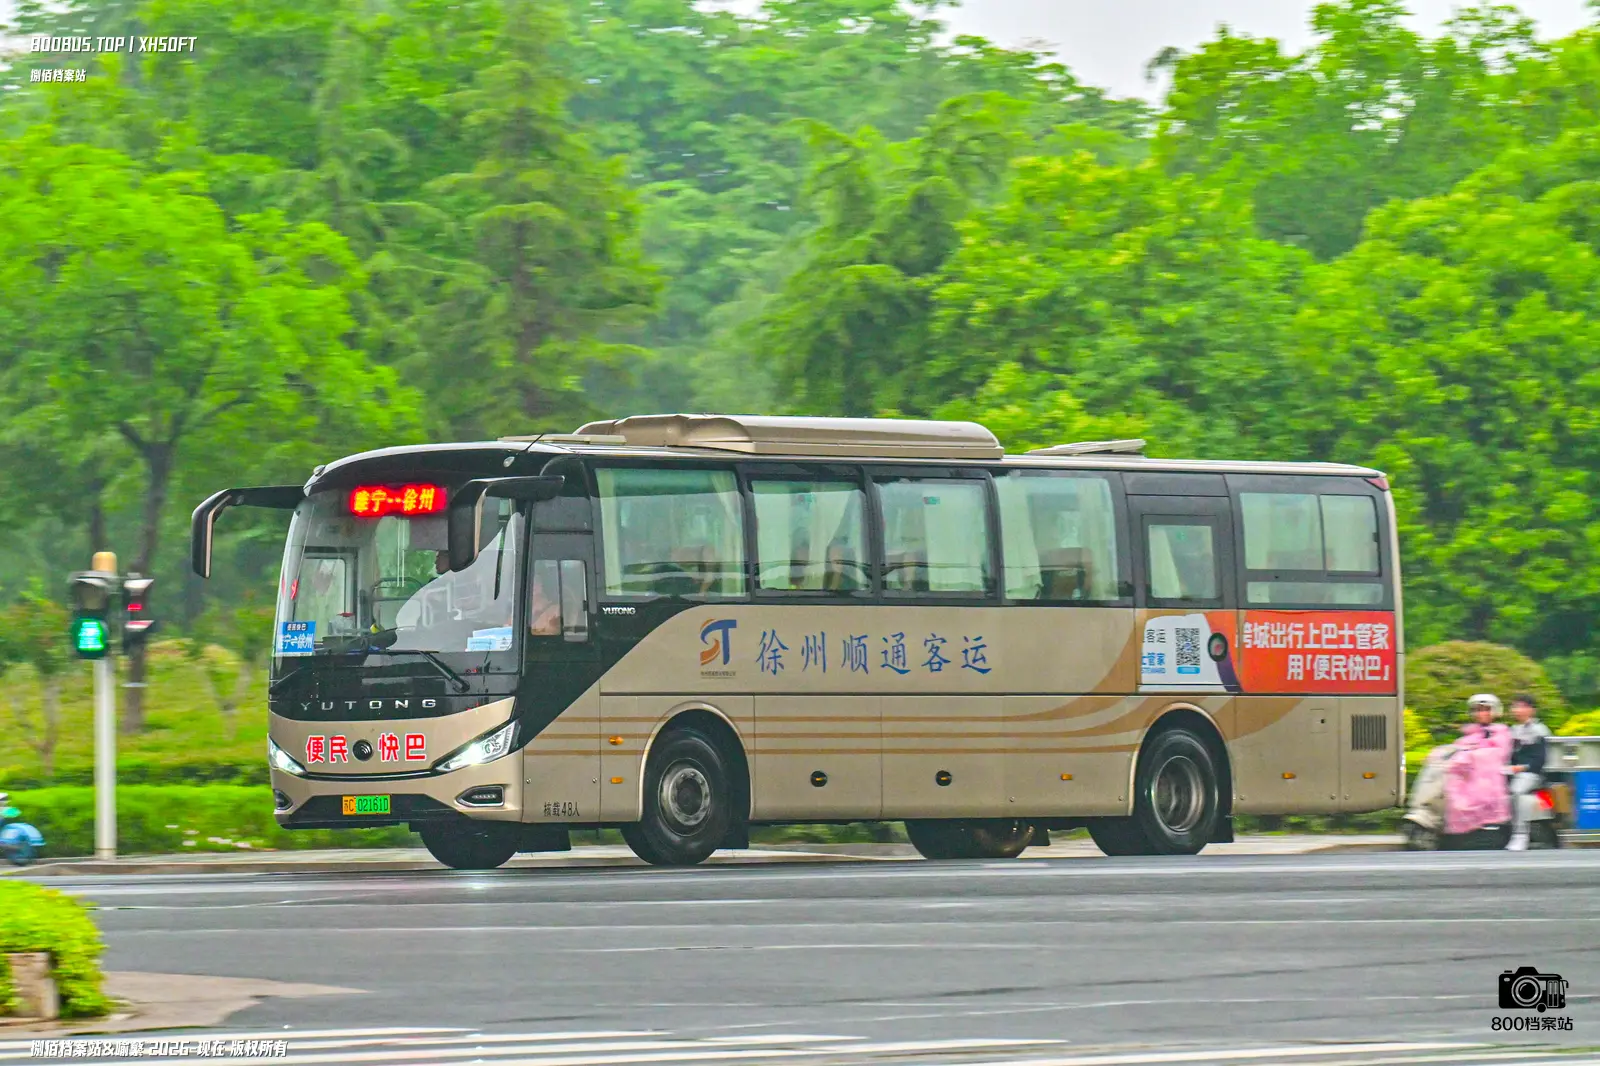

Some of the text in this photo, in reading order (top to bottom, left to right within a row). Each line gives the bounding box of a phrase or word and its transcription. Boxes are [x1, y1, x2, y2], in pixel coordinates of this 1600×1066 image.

[602, 606, 637, 615] YUTONG
[755, 629, 993, 675] 徐州顺通客运
[300, 698, 437, 711] YUTONG
[305, 732, 426, 764] 便民 快巴
